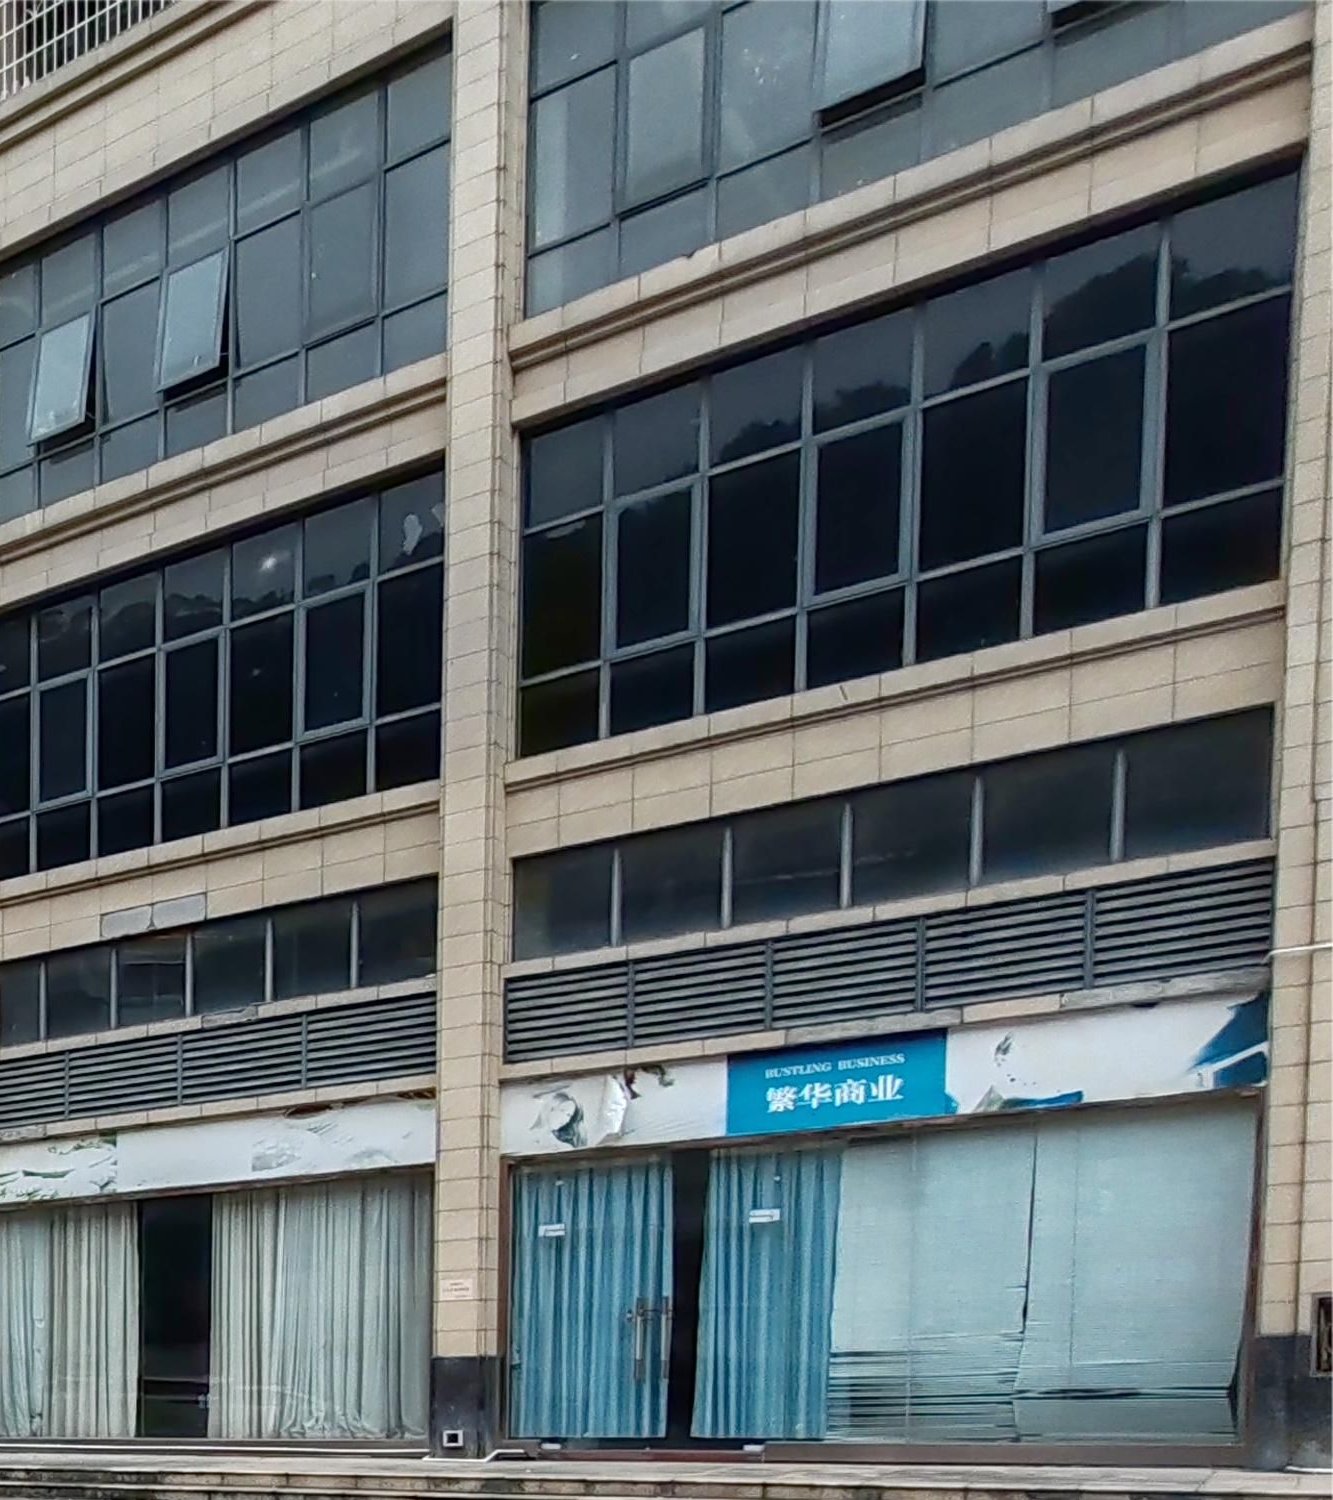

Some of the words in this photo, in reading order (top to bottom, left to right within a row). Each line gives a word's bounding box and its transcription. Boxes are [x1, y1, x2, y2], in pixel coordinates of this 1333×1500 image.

[765, 1061, 832, 1079] BUSTLING
[837, 1053, 905, 1071] BUSINESS
[765, 1074, 904, 1113] 繁华商业
